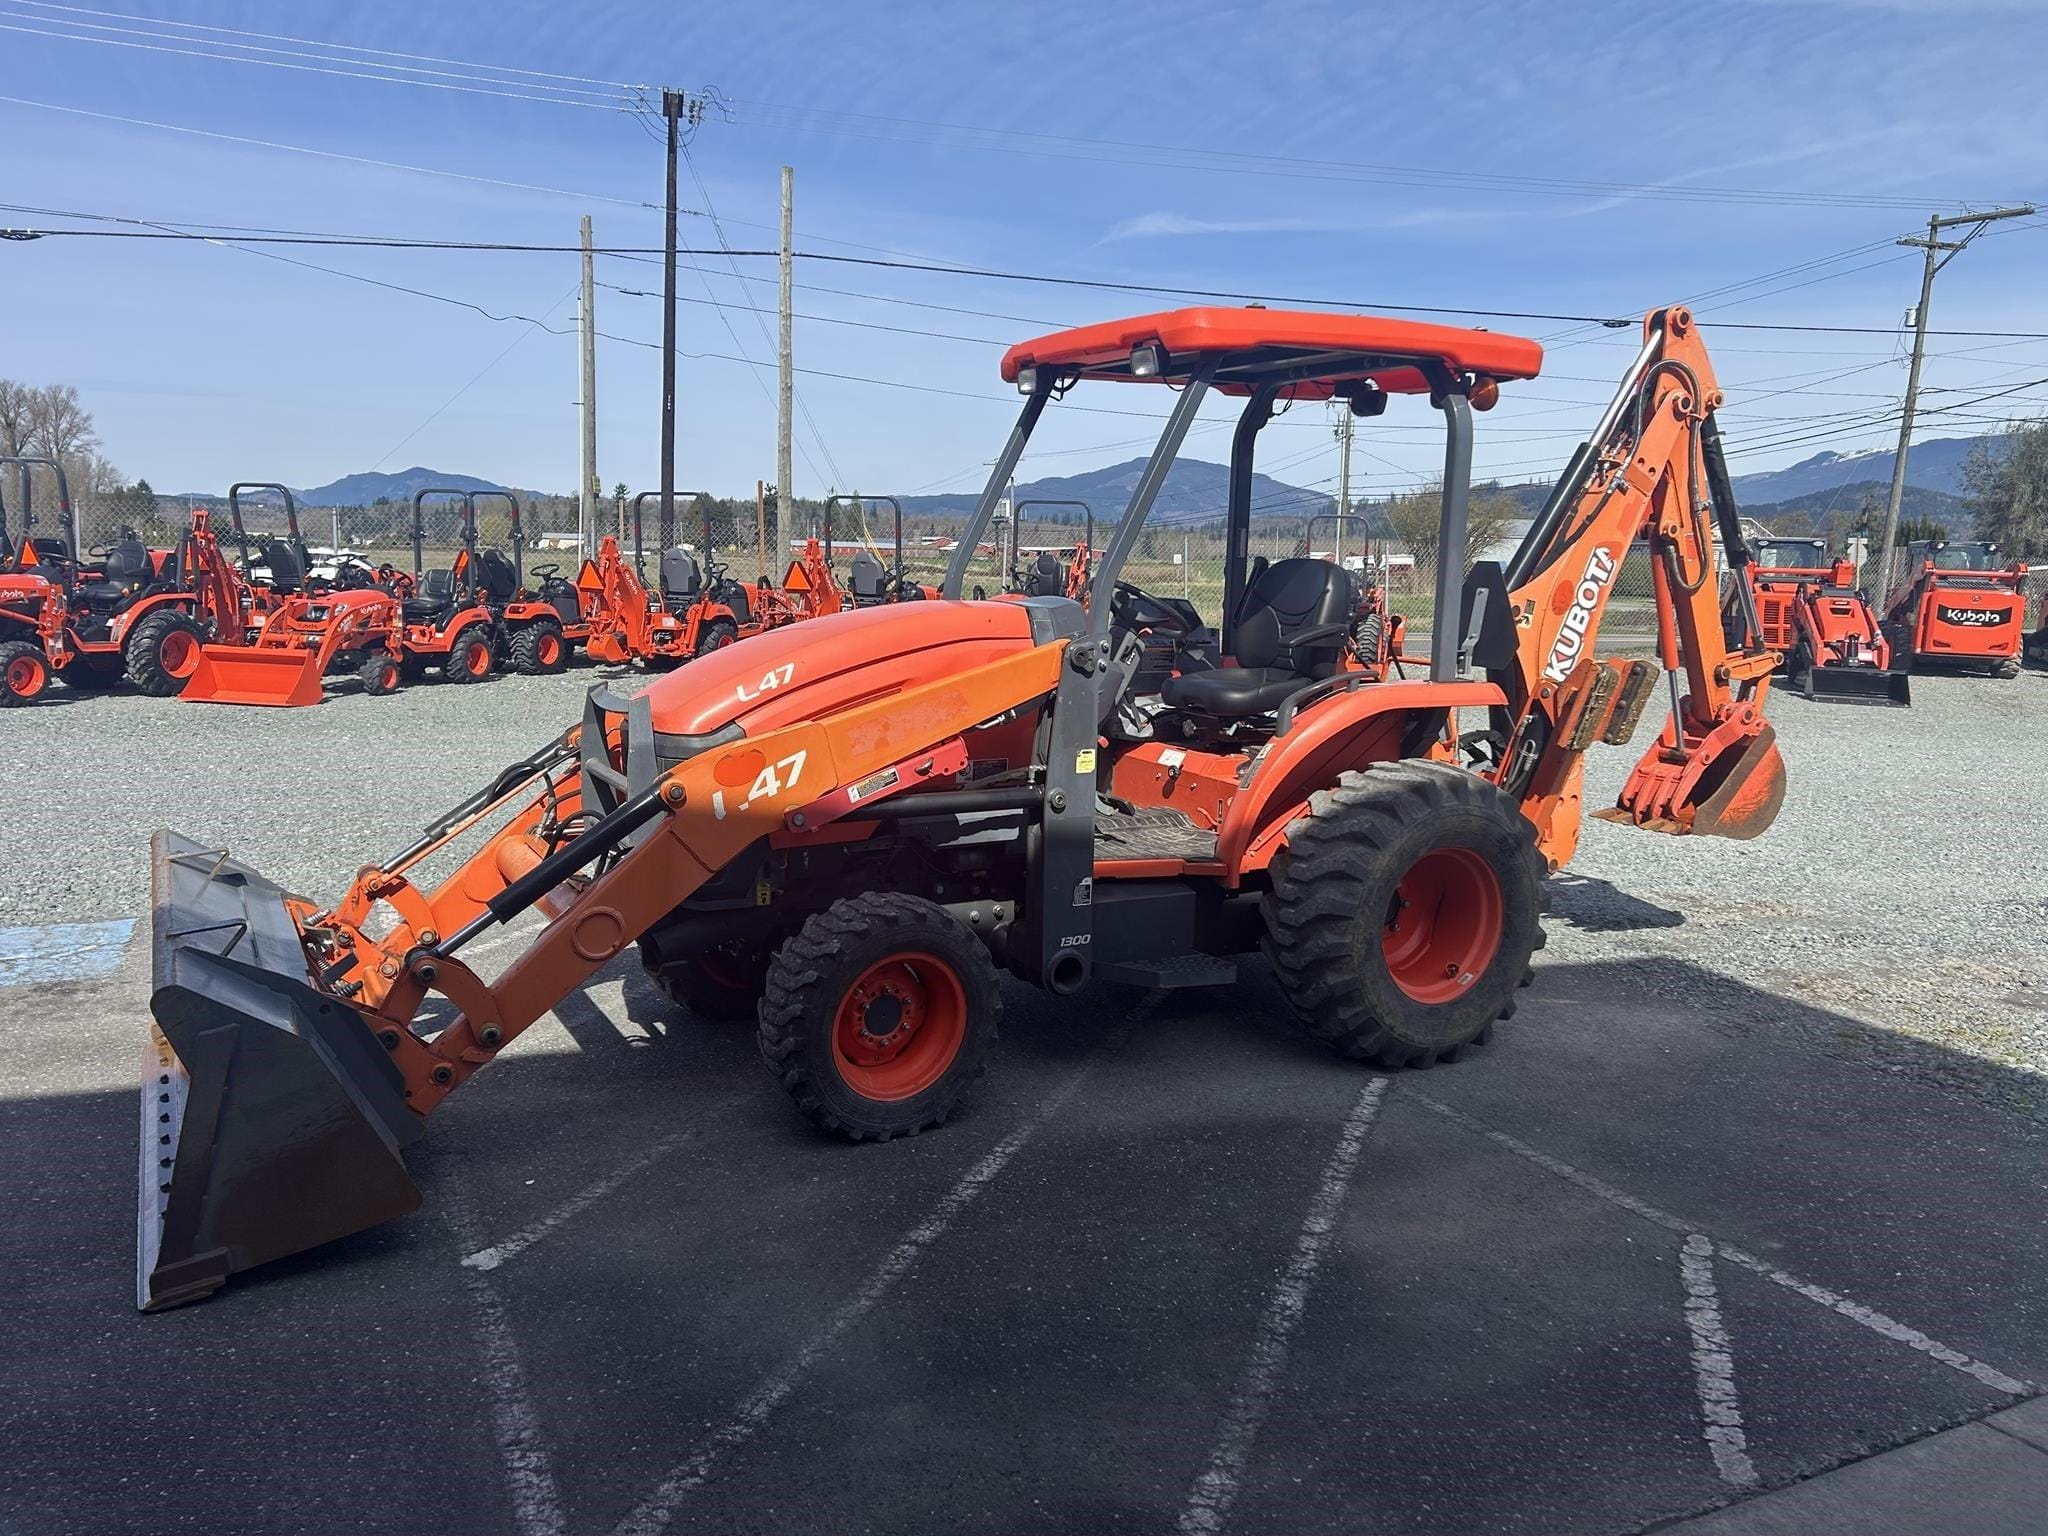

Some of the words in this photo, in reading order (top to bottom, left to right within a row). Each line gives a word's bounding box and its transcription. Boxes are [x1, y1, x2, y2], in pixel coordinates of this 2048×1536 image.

[0, 589, 25, 598] ubota
[1544, 546, 1614, 683] KUBOTA
[1947, 609, 2000, 623] Kubota
[735, 661, 795, 702] L47
[1060, 934, 1091, 947] 1300
